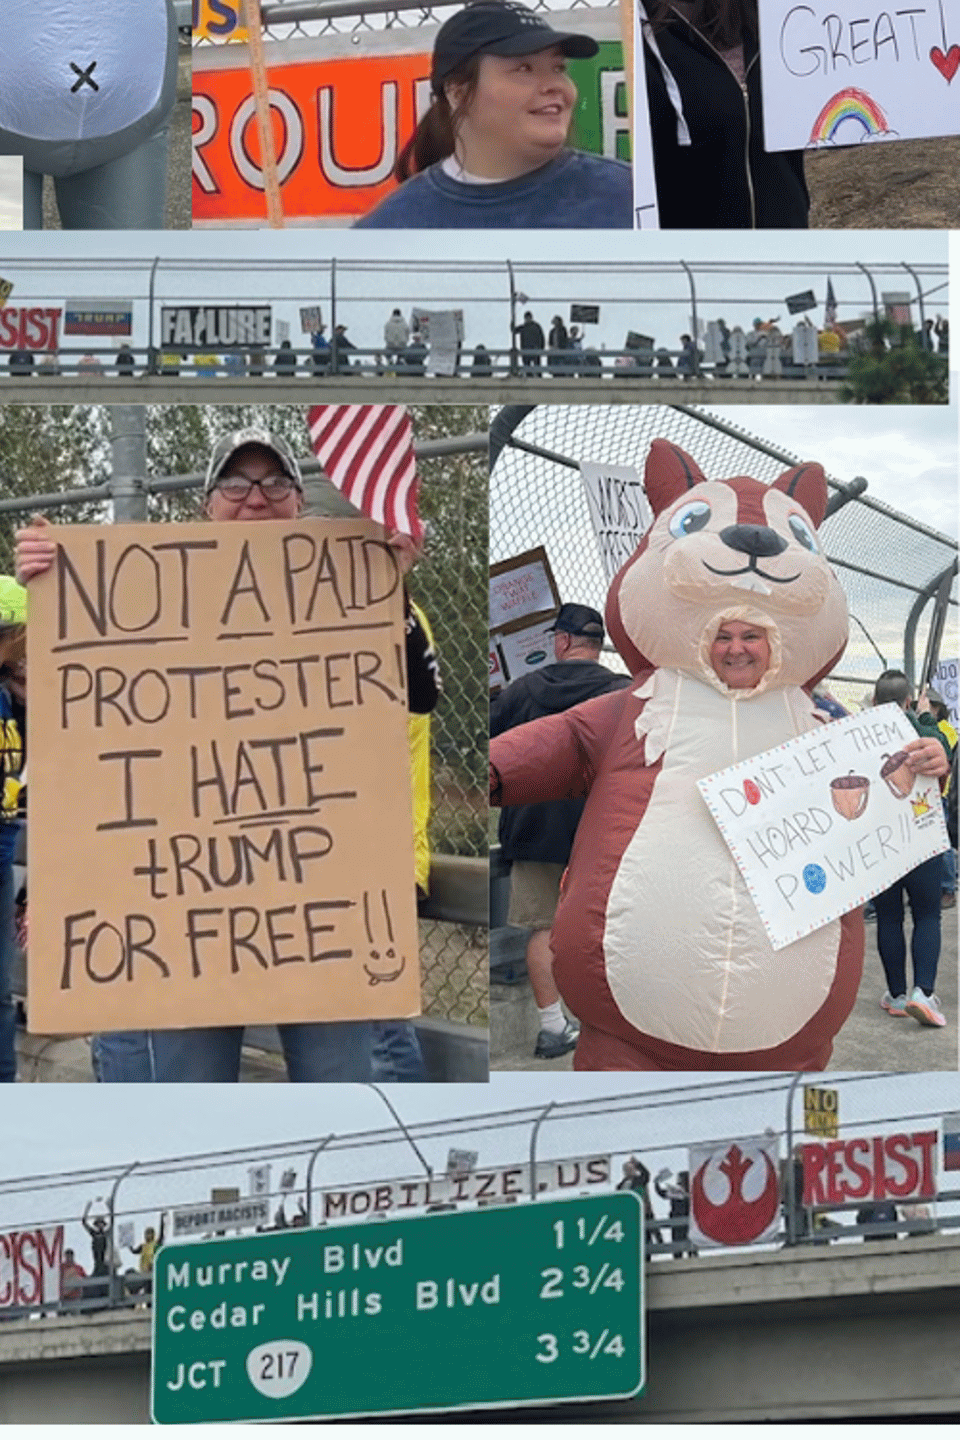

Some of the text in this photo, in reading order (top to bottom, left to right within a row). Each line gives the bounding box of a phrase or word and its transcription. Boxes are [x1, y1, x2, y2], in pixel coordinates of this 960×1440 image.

[74, 312, 126, 324] TRUMP
[55, 531, 401, 640] NOT A PAID
[58, 643, 406, 730] PROTESTER!
[792, 739, 837, 777] LET
[845, 721, 906, 753] THEM
[96, 727, 357, 832] I HATE
[746, 807, 833, 869] HOARD
[59, 910, 170, 991] FOR
[806, 1088, 838, 1111] NO
[802, 1130, 938, 1208] RESIST
[167, 1254, 291, 1293] Murray
[323, 1239, 405, 1274] Blvd
[167, 1299, 265, 1334] Cedar
[297, 1286, 383, 1322] Hills
[416, 1275, 502, 1311] Blvd
[166, 1360, 227, 1392] JCT
[260, 1351, 300, 1381] 217
